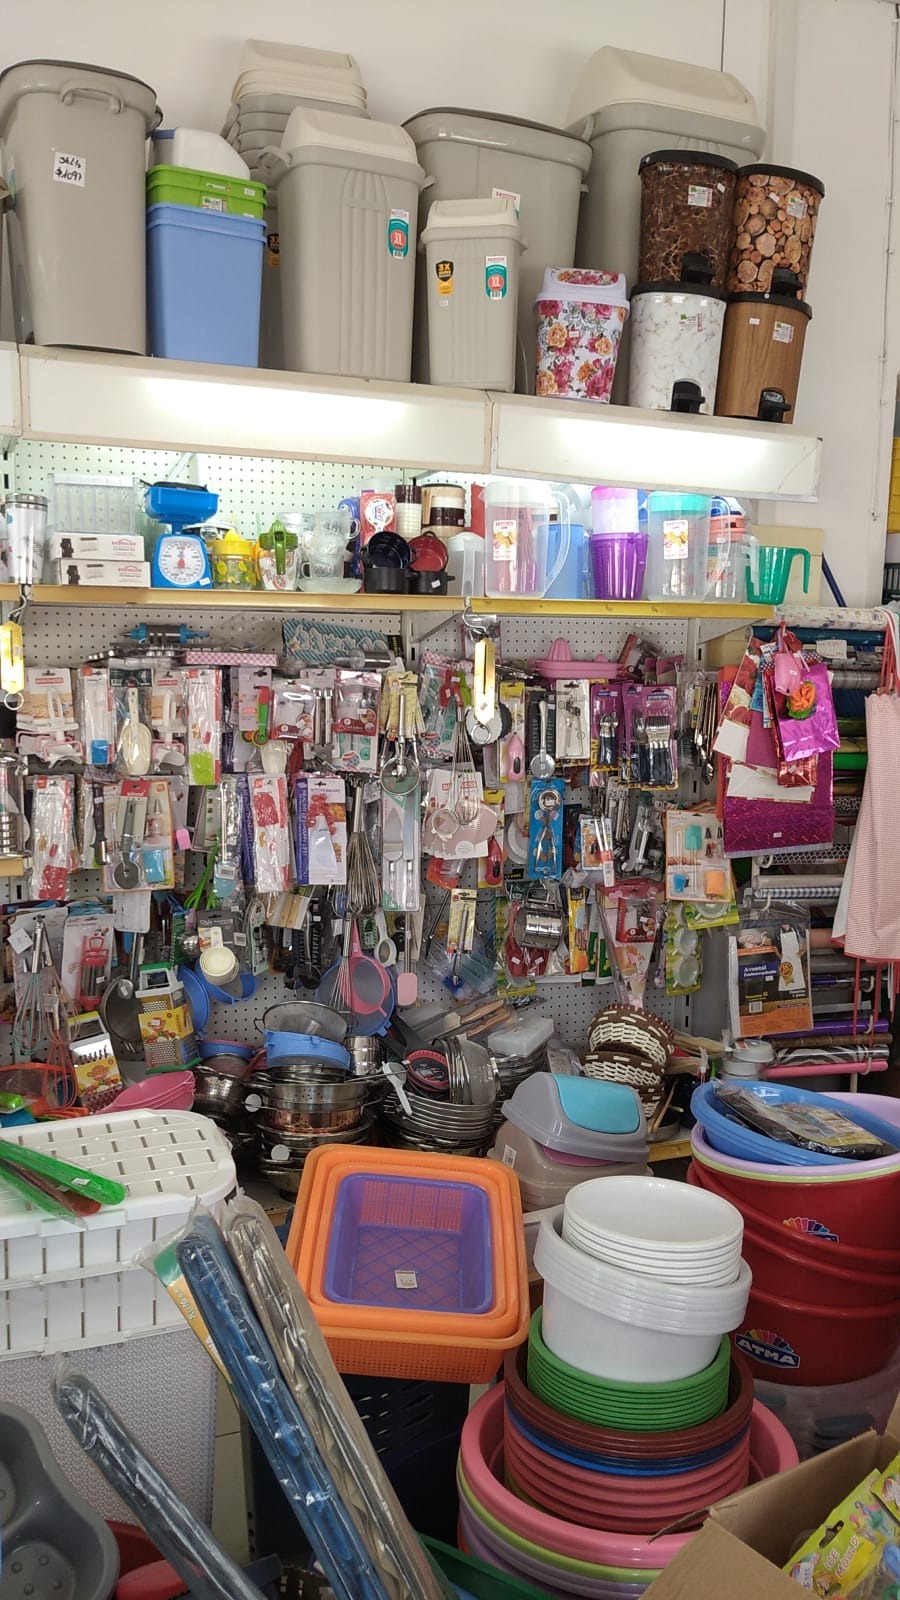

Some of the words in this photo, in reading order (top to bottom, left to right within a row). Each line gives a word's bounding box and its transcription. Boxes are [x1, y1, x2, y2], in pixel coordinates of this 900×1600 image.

[737, 1338, 797, 1366] ATMA
[824, 1547, 840, 1570] ICE
[835, 1535, 859, 1577] MOULD
